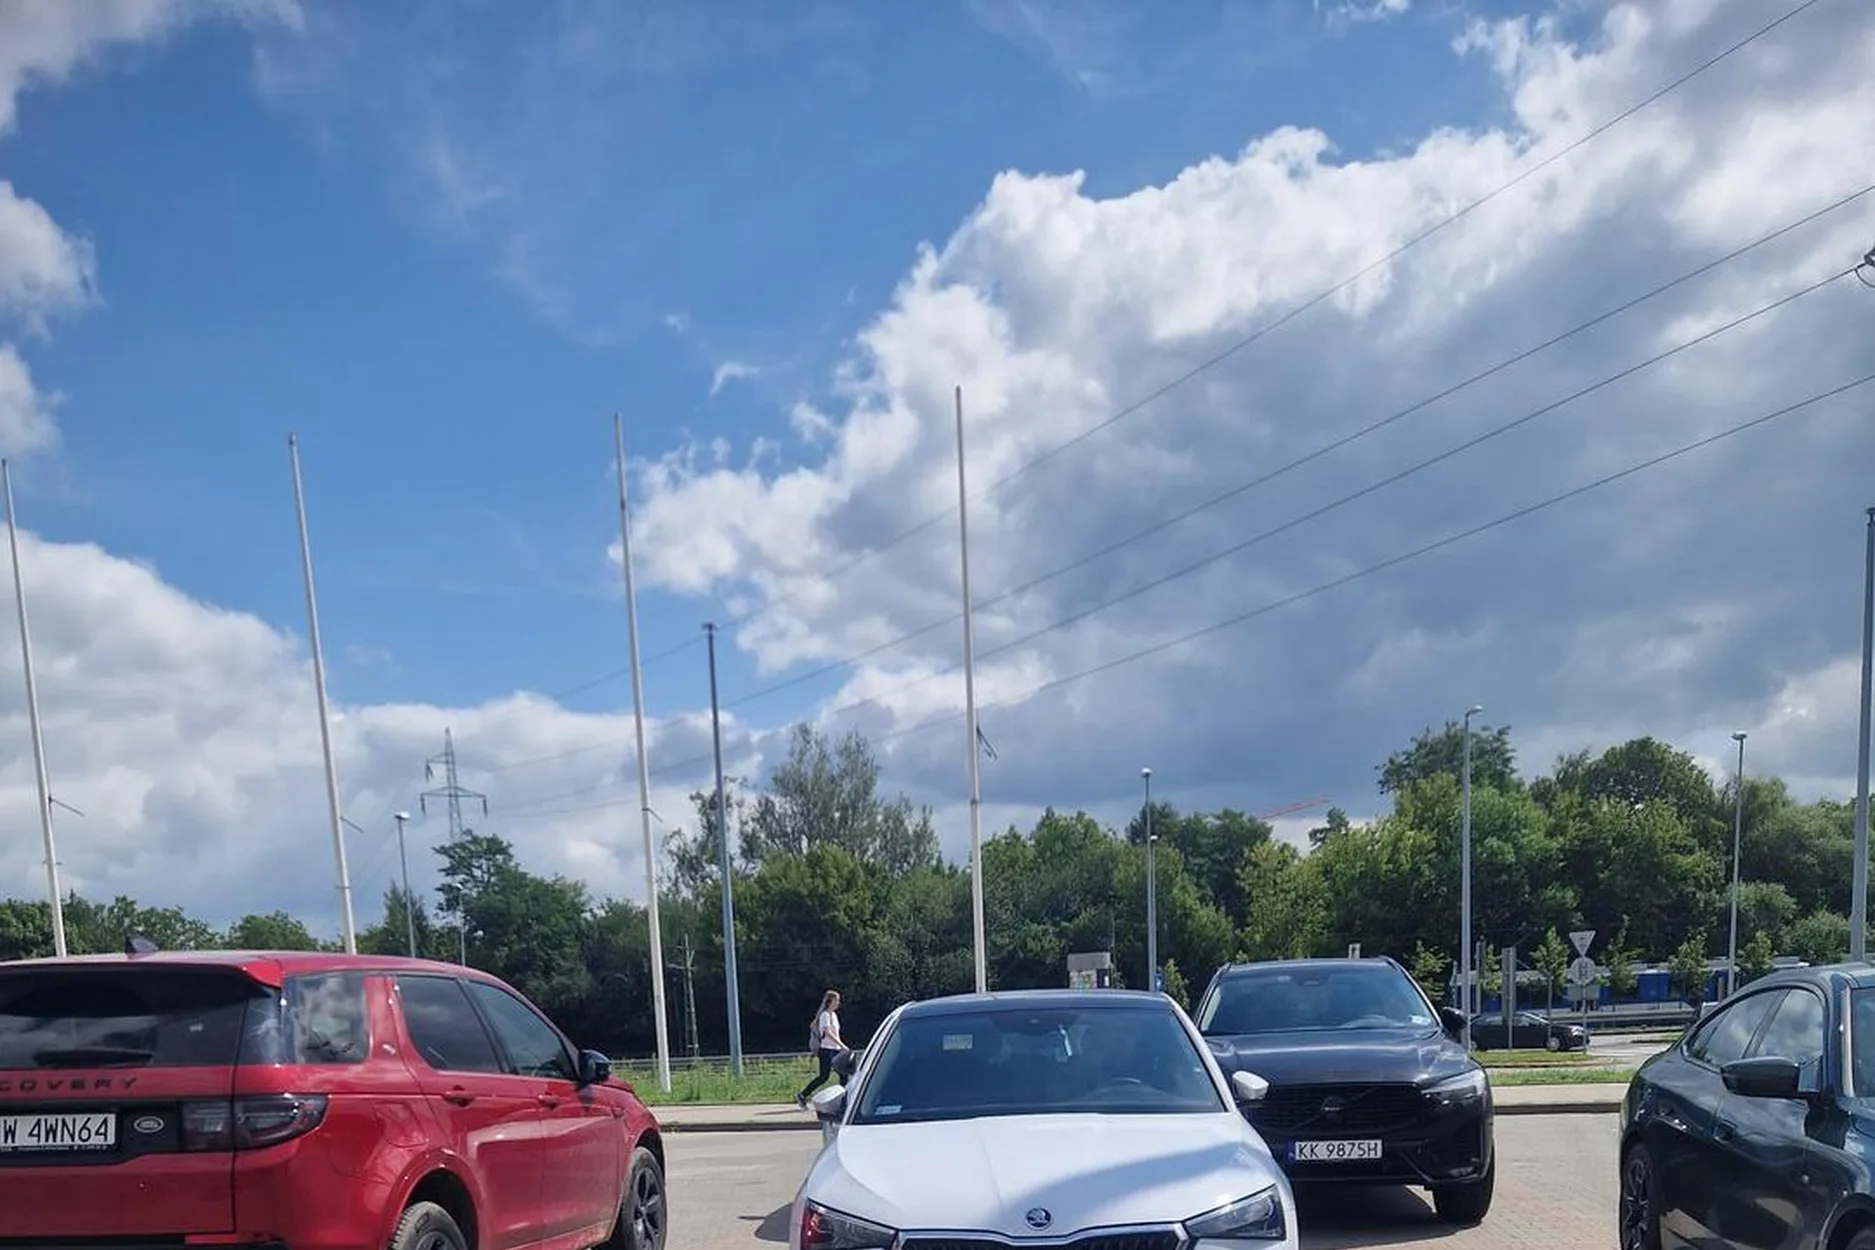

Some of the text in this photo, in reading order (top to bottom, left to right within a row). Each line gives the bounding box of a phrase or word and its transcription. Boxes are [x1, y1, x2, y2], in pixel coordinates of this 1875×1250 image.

[27, 1117, 109, 1143] 4WN64
[1298, 1143, 1319, 1159] KK
[1325, 1142, 1378, 1158] 9875H
